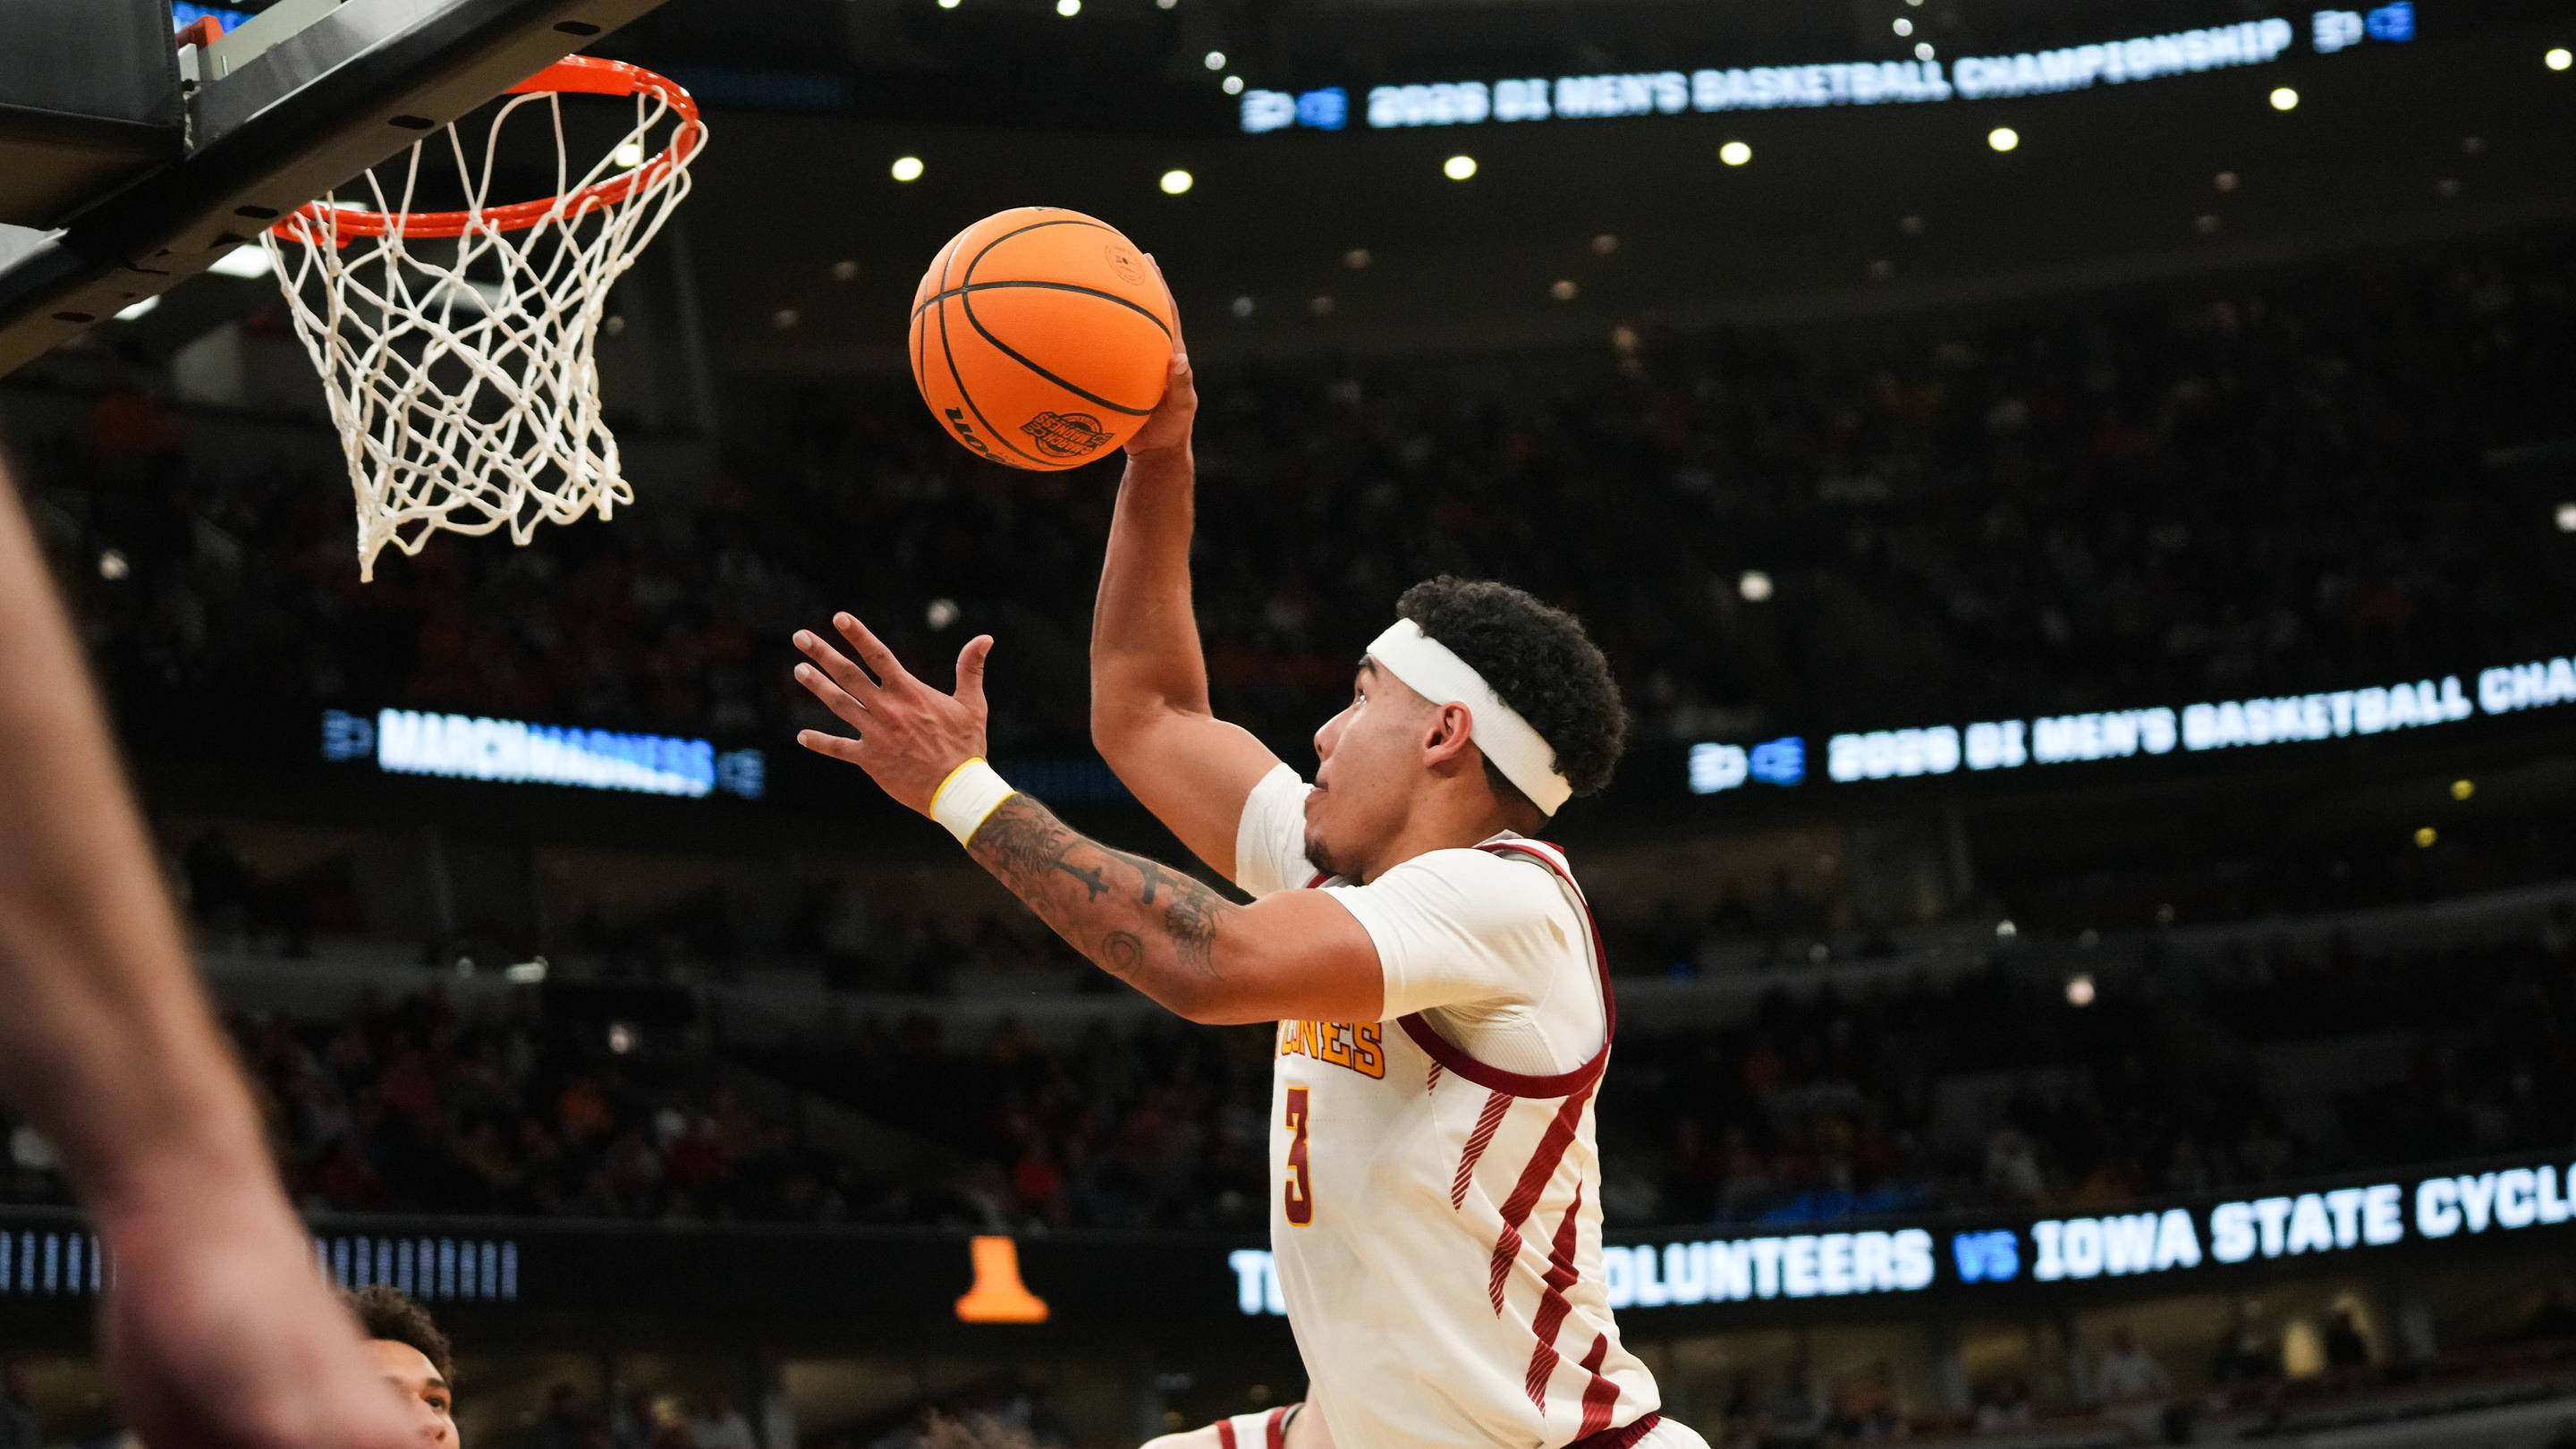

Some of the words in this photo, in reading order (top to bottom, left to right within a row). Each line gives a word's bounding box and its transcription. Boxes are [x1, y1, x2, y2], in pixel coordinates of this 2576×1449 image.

[1555, 72, 1689, 118] MEN'S
[1690, 60, 1952, 113] BASKETBALL
[1953, 18, 2292, 100] CHAMPIONSHIP
[2031, 707, 2177, 764] MEN'S
[2182, 676, 2473, 751] BASKETBALL
[2478, 657, 2576, 715] CHA
[1284, 1085, 1314, 1228] 3
[1602, 1229, 1935, 1309] OLUNTEERS
[1953, 1230, 2020, 1283] VS
[2030, 1208, 2202, 1282] IOWA
[2210, 1183, 2404, 1264] STATE
[2415, 1162, 2576, 1239] CYCL
